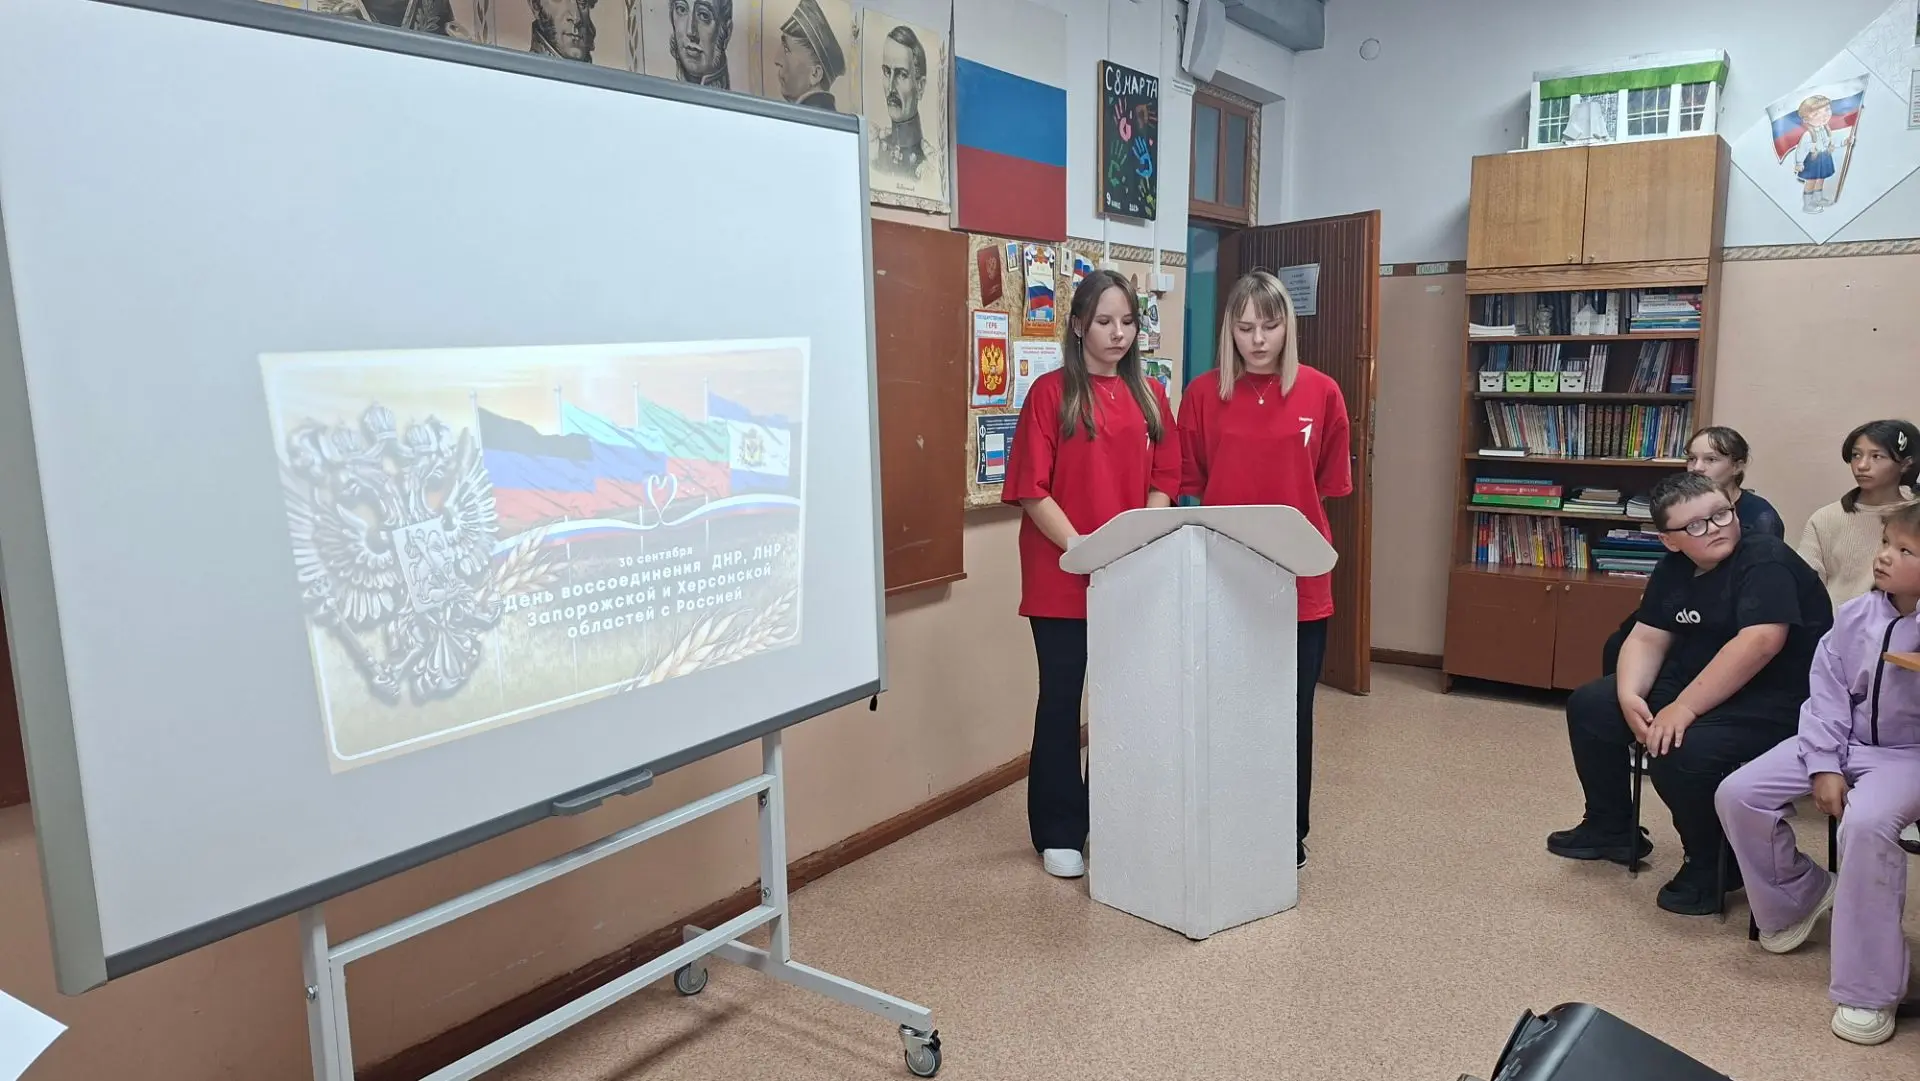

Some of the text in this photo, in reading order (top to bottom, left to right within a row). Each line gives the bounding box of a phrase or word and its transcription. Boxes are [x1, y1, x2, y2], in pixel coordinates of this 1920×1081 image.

[1122, 73, 1158, 98] МАРТА
[619, 545, 693, 567] 30 сентября
[504, 590, 554, 612] День
[561, 560, 701, 599] воссоединения
[712, 550, 747, 570] ДНР,
[527, 566, 771, 627] Запорожской и Херсонской
[568, 589, 742, 638] областей с Россией
